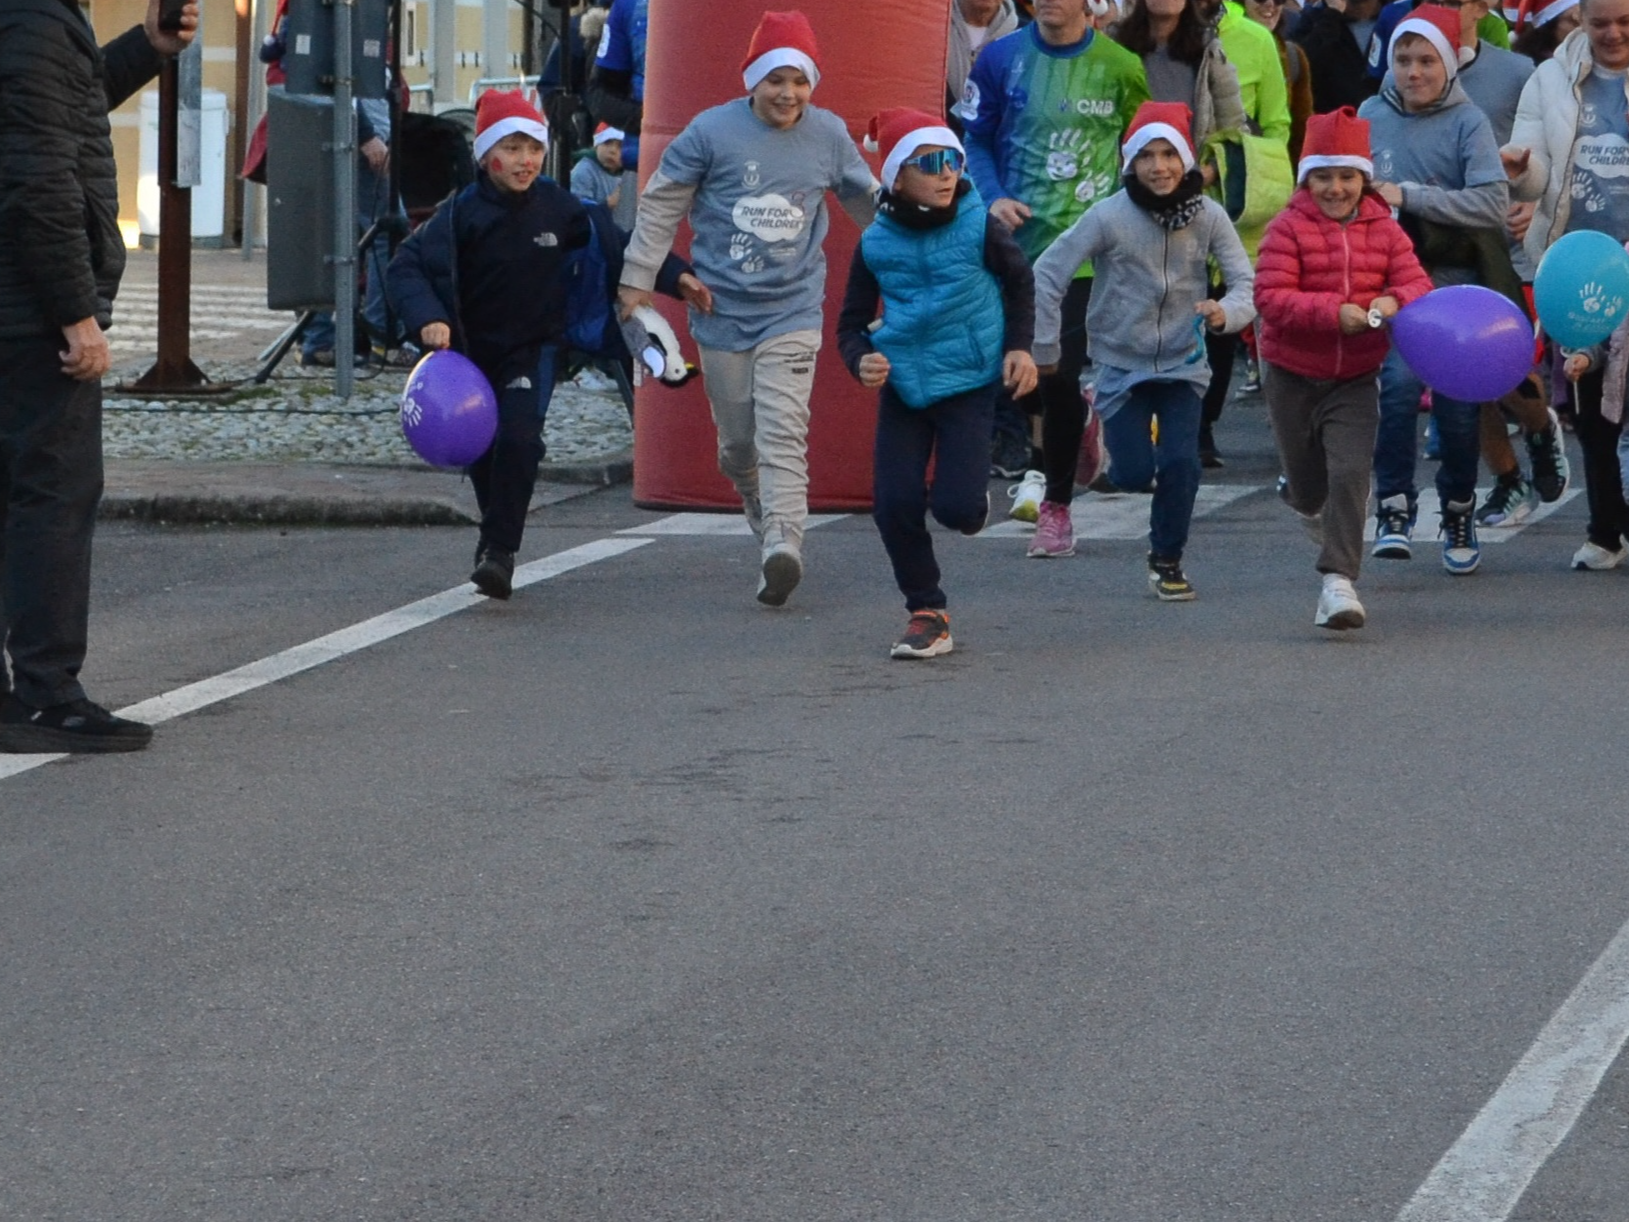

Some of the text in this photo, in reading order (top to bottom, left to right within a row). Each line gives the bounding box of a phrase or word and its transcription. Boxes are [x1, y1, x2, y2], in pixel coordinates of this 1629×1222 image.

[1076, 99, 1115, 115] CMB
[1580, 144, 1628, 156] RUN FOR
[741, 206, 791, 219] RUN FOR
